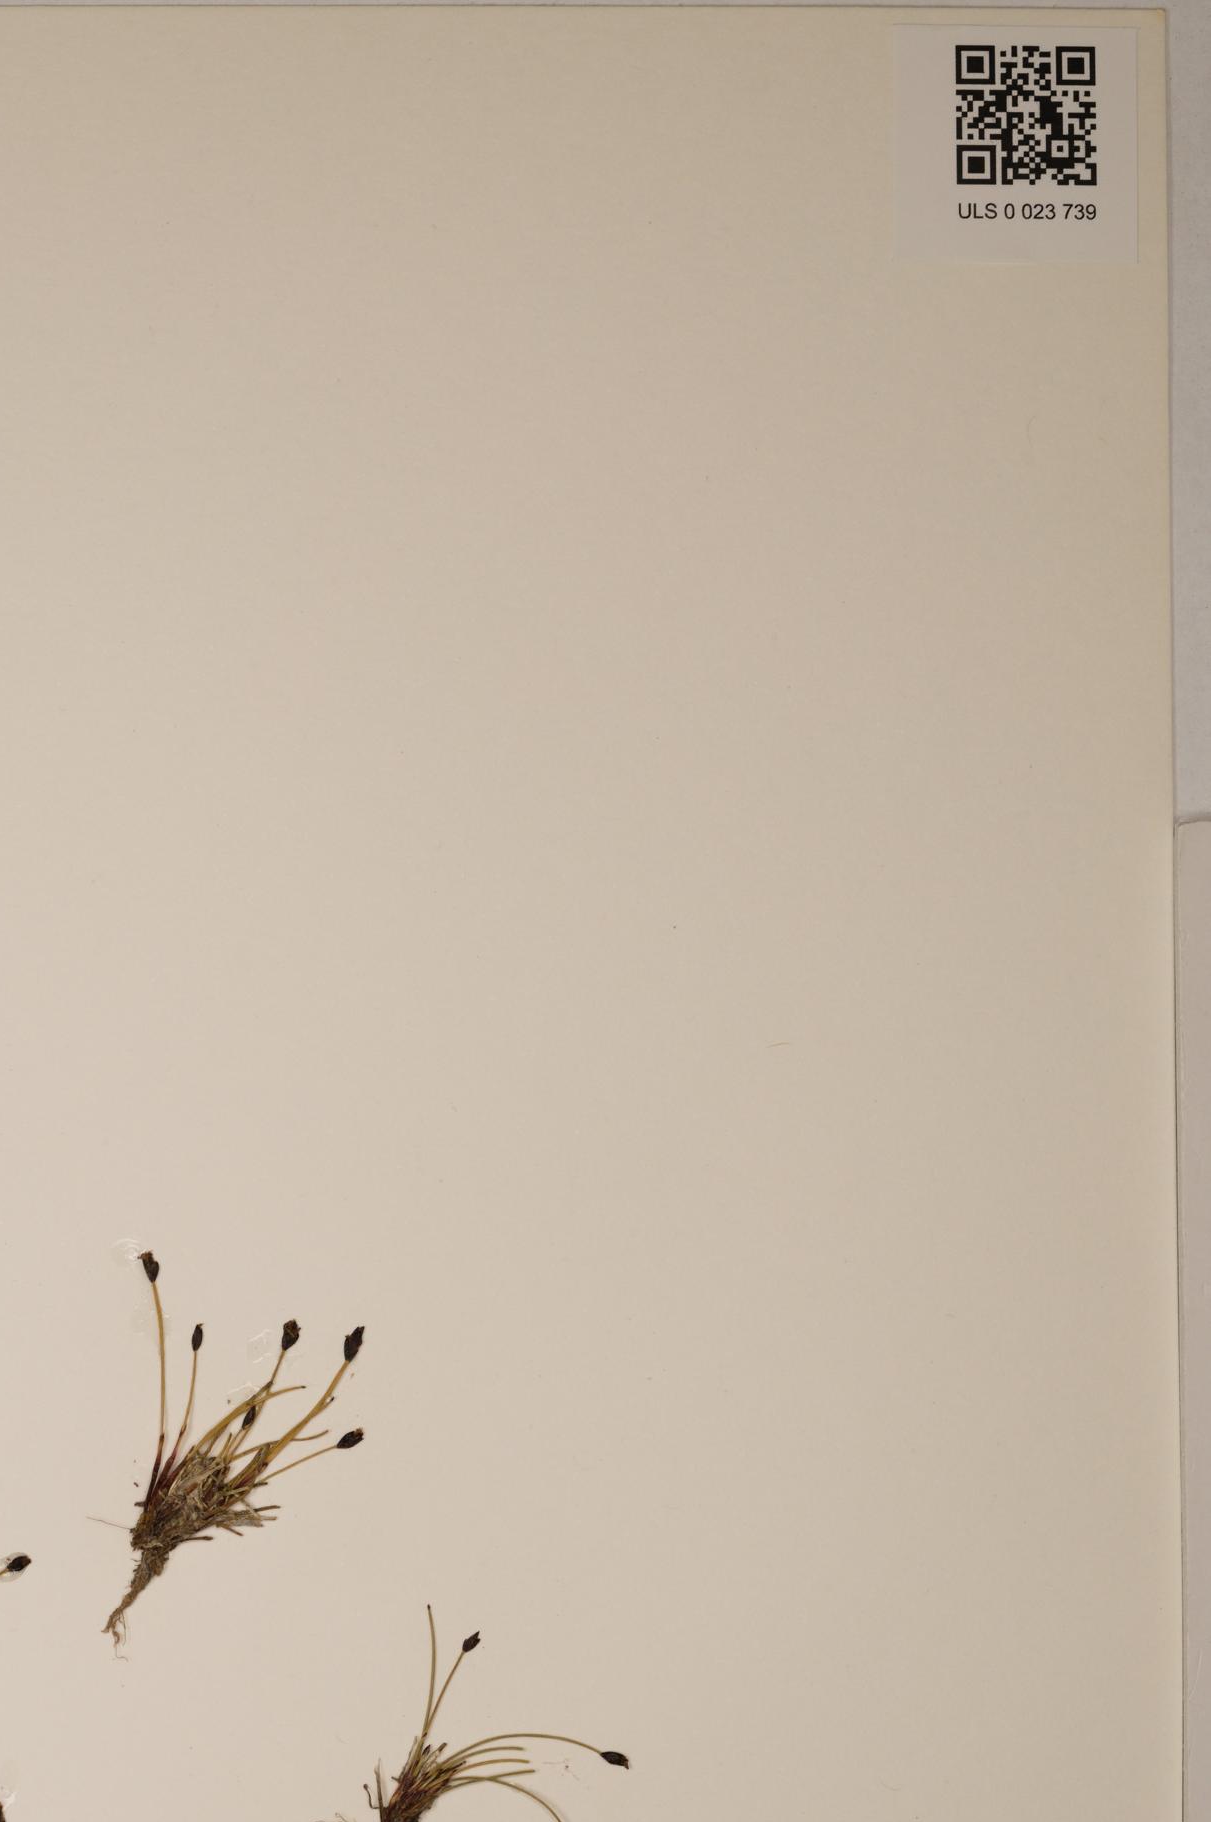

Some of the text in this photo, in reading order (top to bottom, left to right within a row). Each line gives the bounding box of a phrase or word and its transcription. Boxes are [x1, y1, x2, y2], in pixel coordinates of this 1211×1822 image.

[958, 203, 1097, 220] ULS 0 023 739
